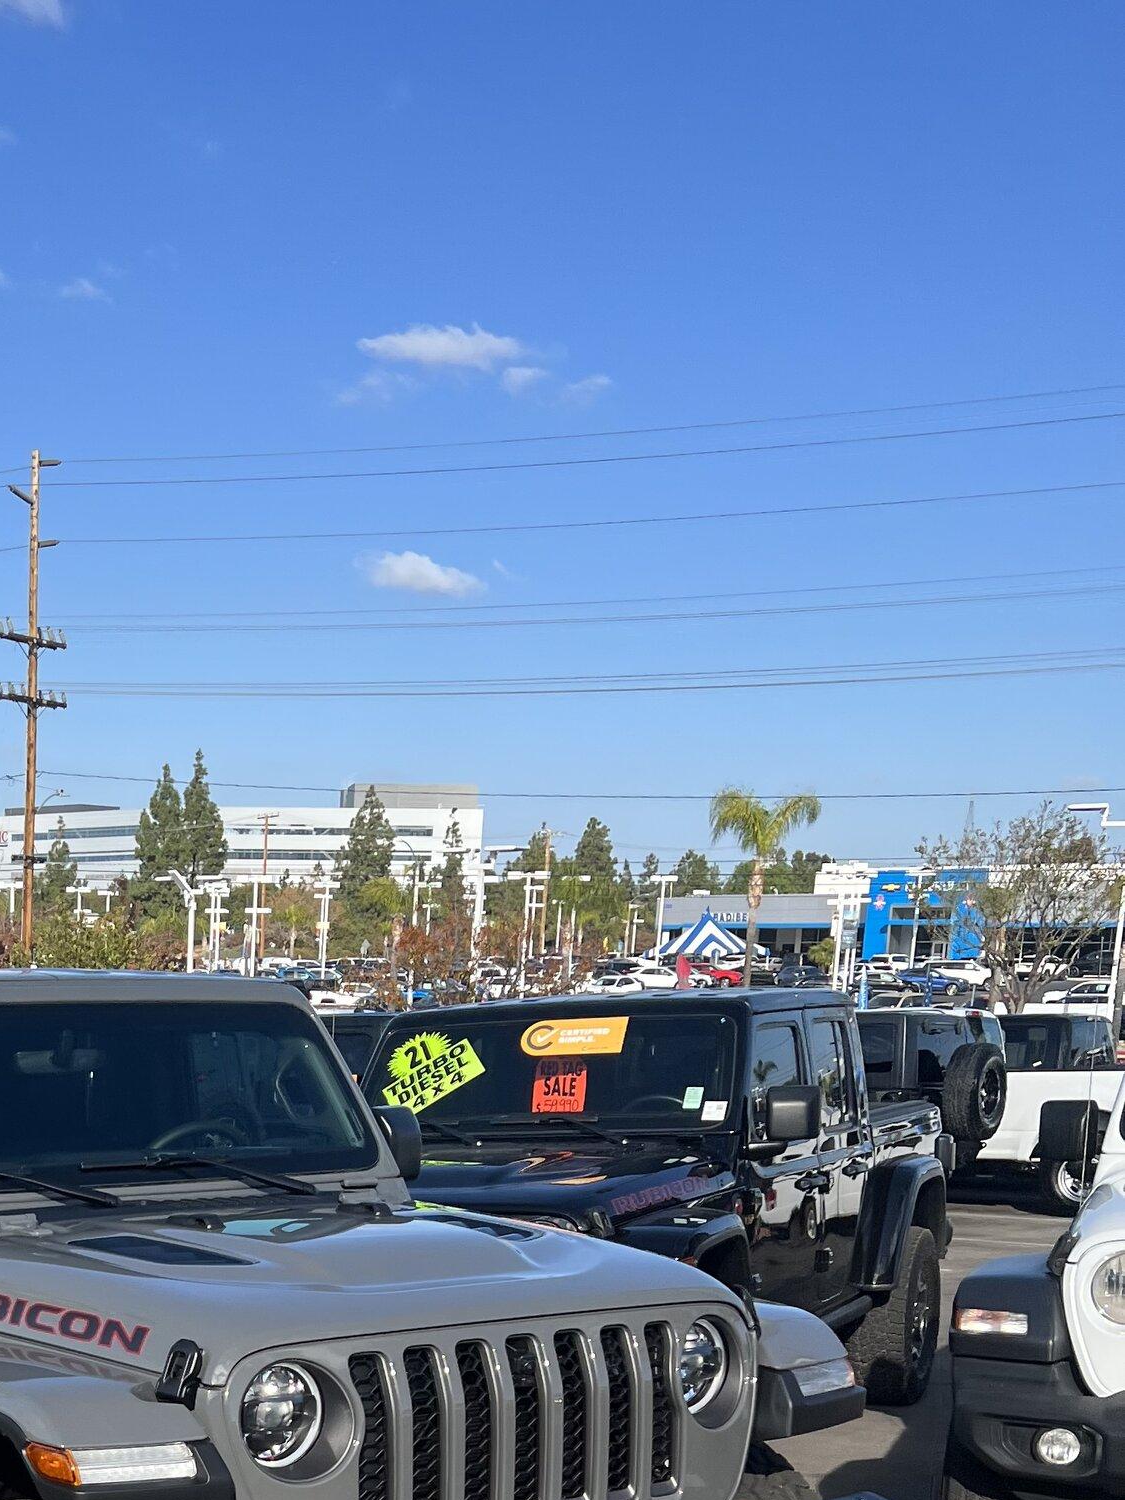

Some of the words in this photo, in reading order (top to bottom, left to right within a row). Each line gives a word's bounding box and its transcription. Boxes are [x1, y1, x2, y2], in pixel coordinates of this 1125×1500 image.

[386, 1043, 467, 1097] TURBO
[404, 1040, 432, 1070] 21
[397, 1057, 470, 1104] DIESEL
[412, 1093, 427, 1108] 4
[449, 1070, 464, 1085] 4
[543, 1076, 577, 1097] SALE
[610, 1177, 710, 1215] RUBICON
